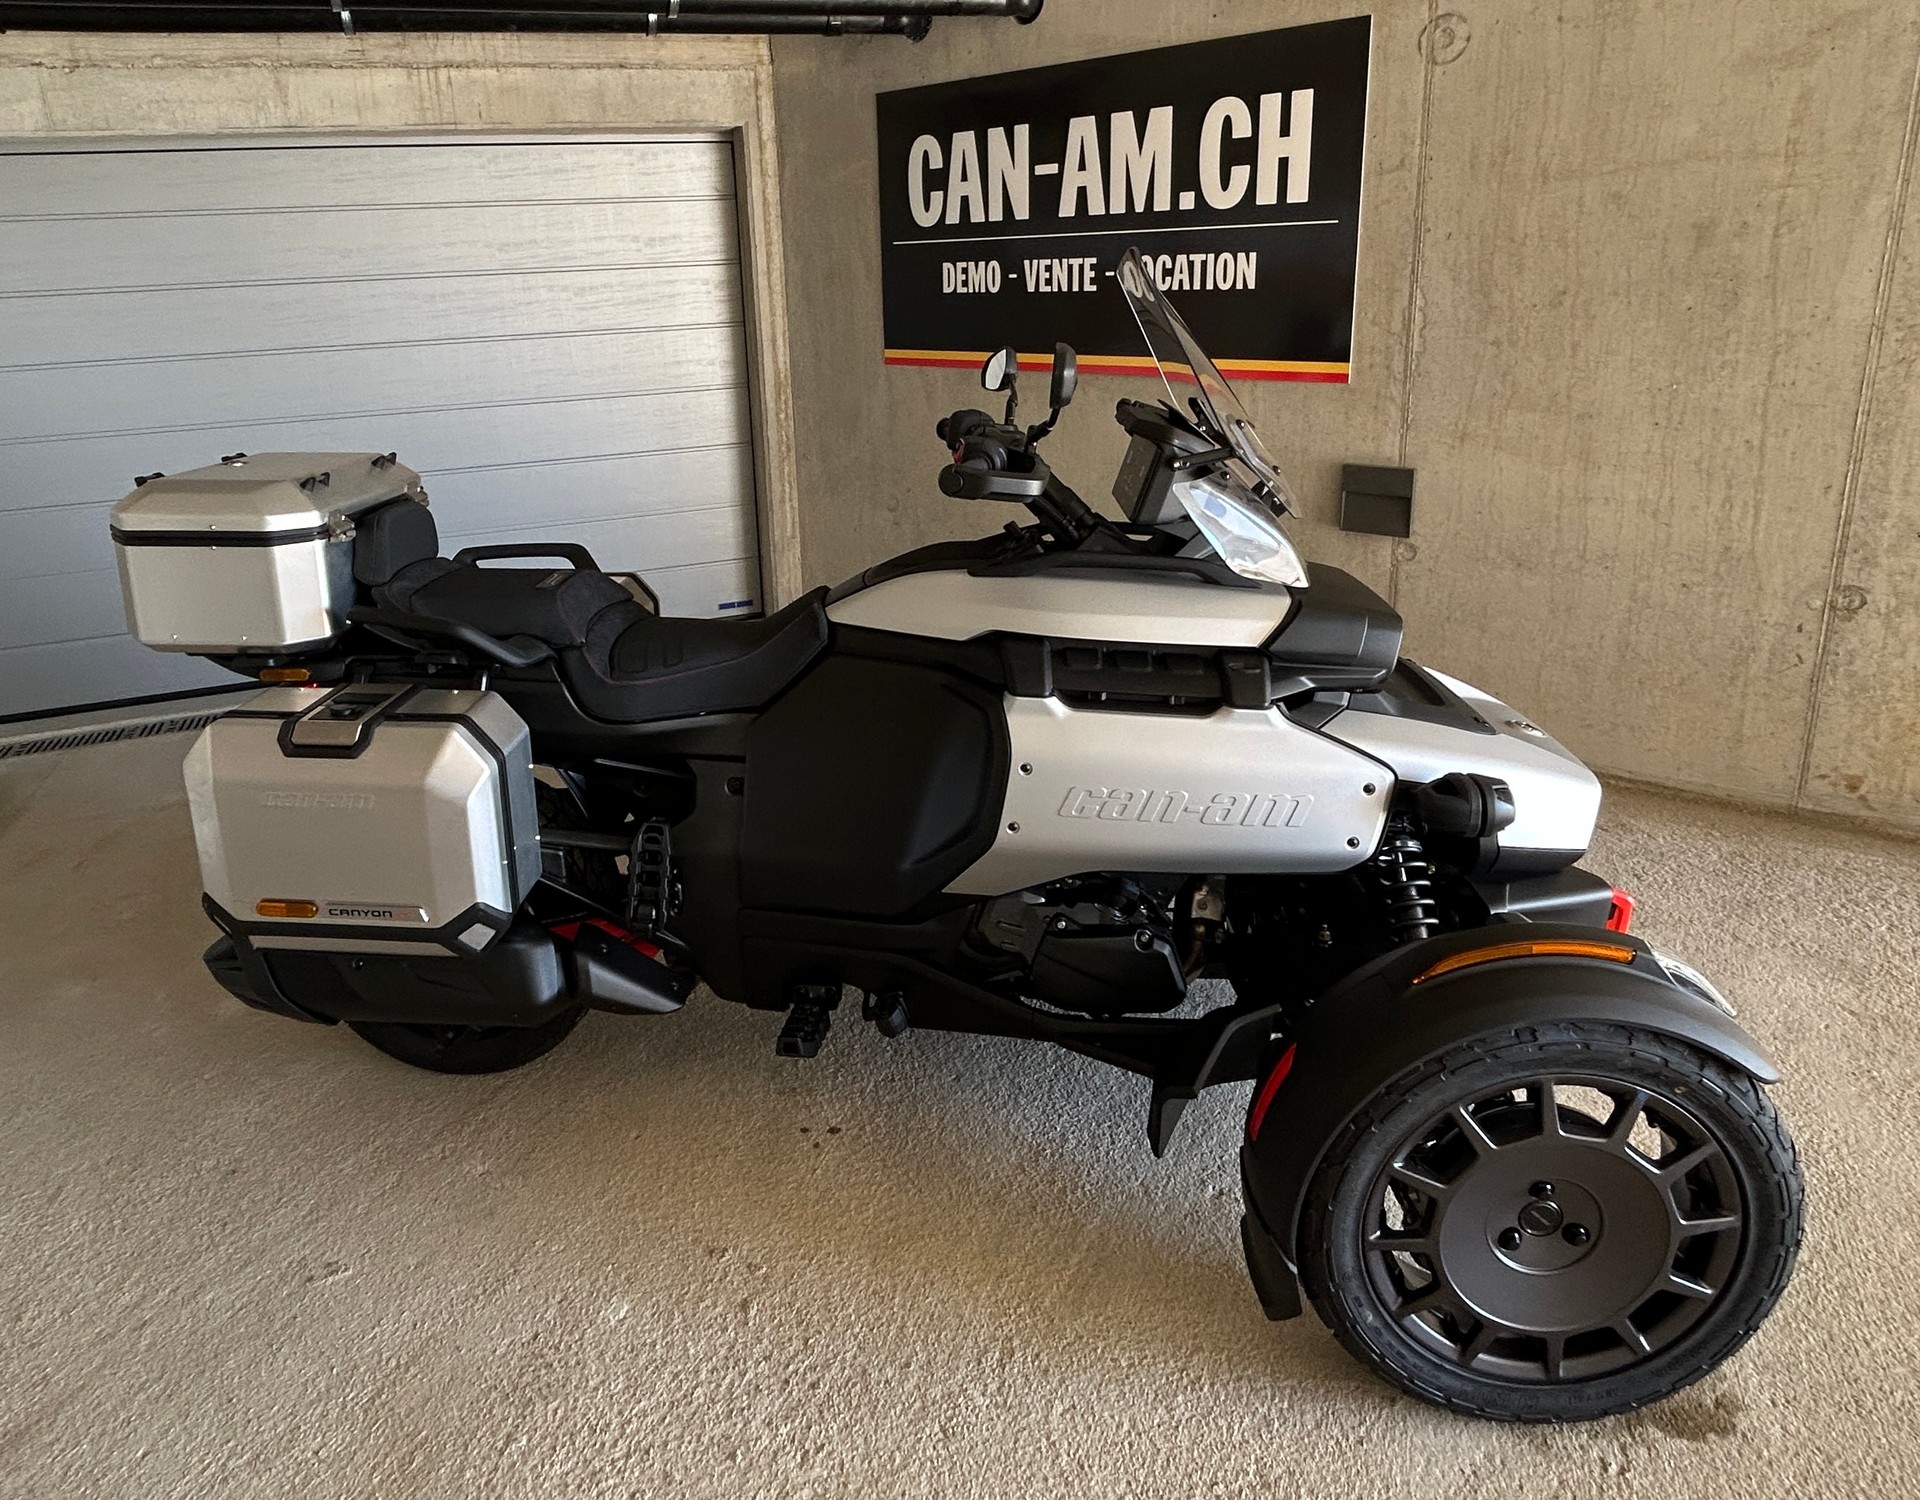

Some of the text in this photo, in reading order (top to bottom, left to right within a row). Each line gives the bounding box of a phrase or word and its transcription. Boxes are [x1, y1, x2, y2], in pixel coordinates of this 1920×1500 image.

[907, 88, 1315, 228] CAN-AM.CH
[942, 259, 1001, 294] DEMO
[1023, 257, 1098, 293] VENTE
[1057, 785, 1316, 828] can-am
[328, 907, 394, 919] CANYON
